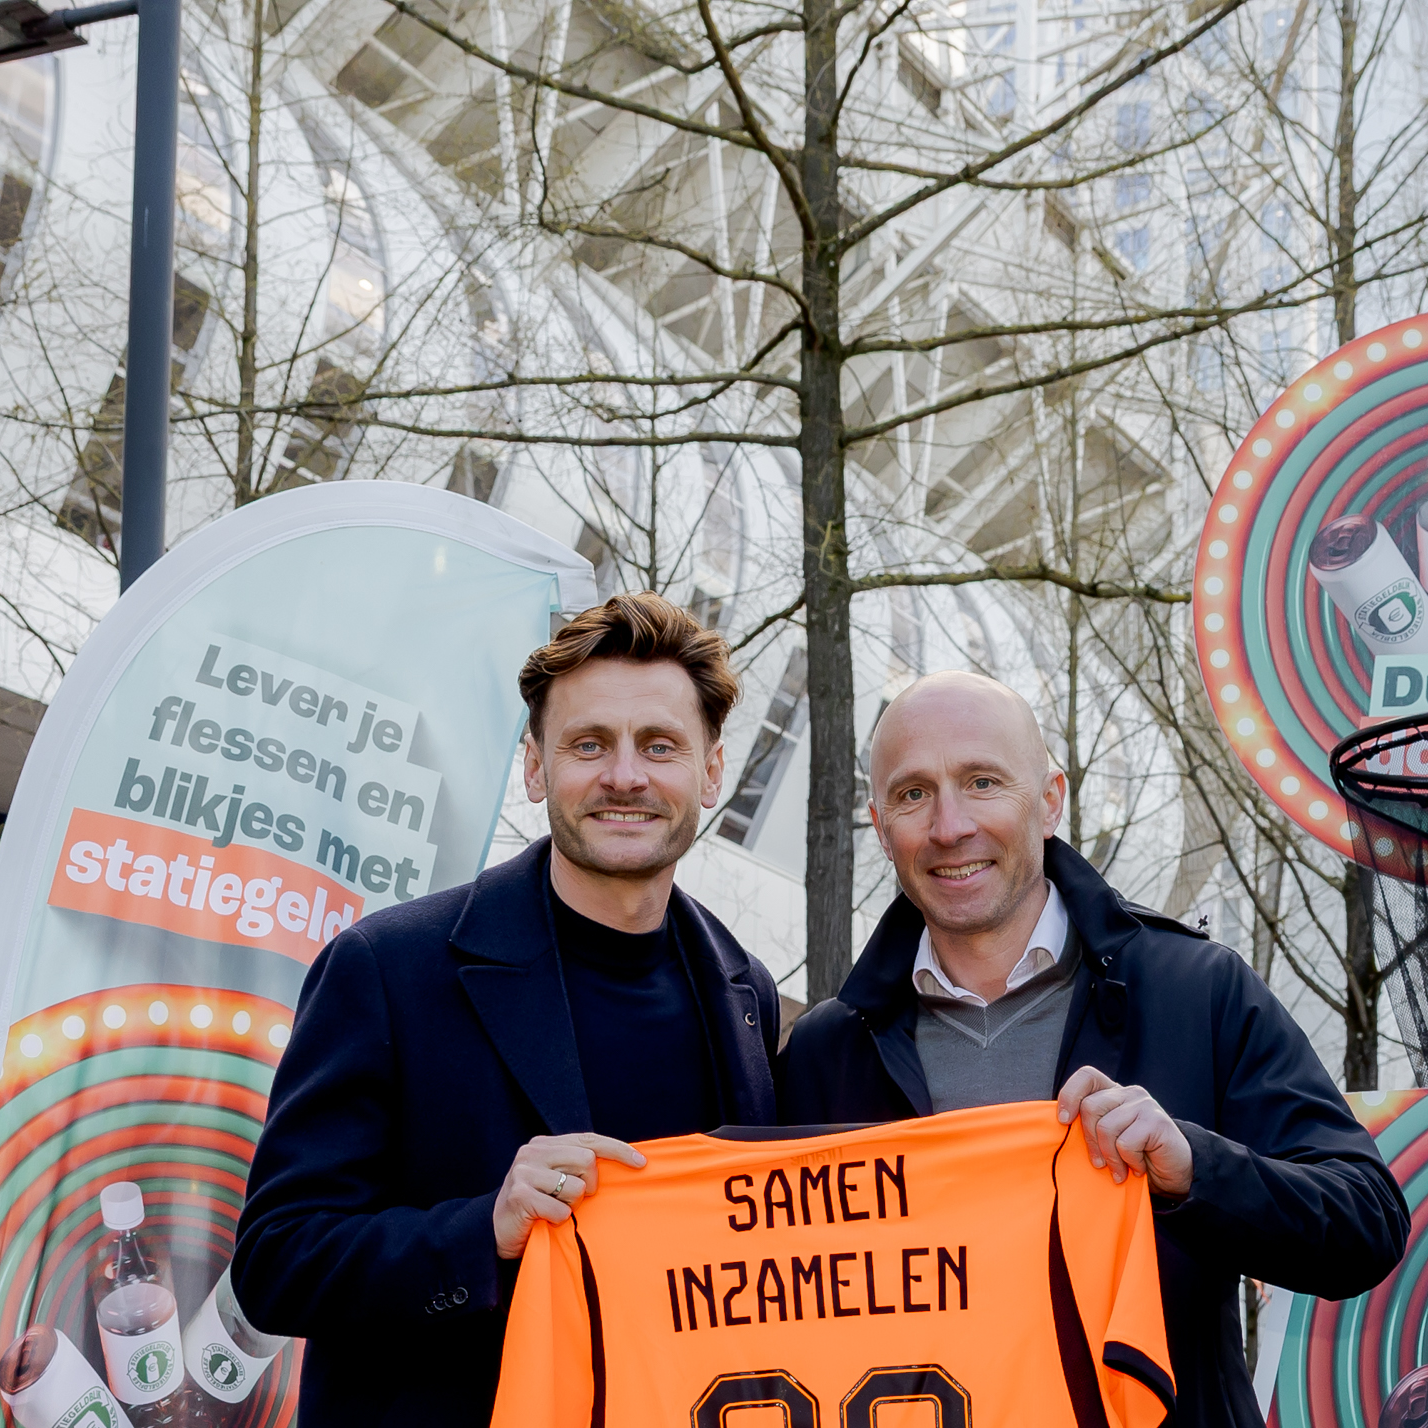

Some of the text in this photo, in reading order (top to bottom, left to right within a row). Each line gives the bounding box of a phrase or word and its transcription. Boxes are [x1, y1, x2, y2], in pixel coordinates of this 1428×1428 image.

[195, 644, 403, 754] Lever je
[148, 695, 425, 832] flessen en
[114, 757, 420, 901] blikjes met
[65, 838, 354, 946] statiegeld
[724, 1154, 909, 1232] SAMEN
[666, 1245, 969, 1332] INZAMELEN
